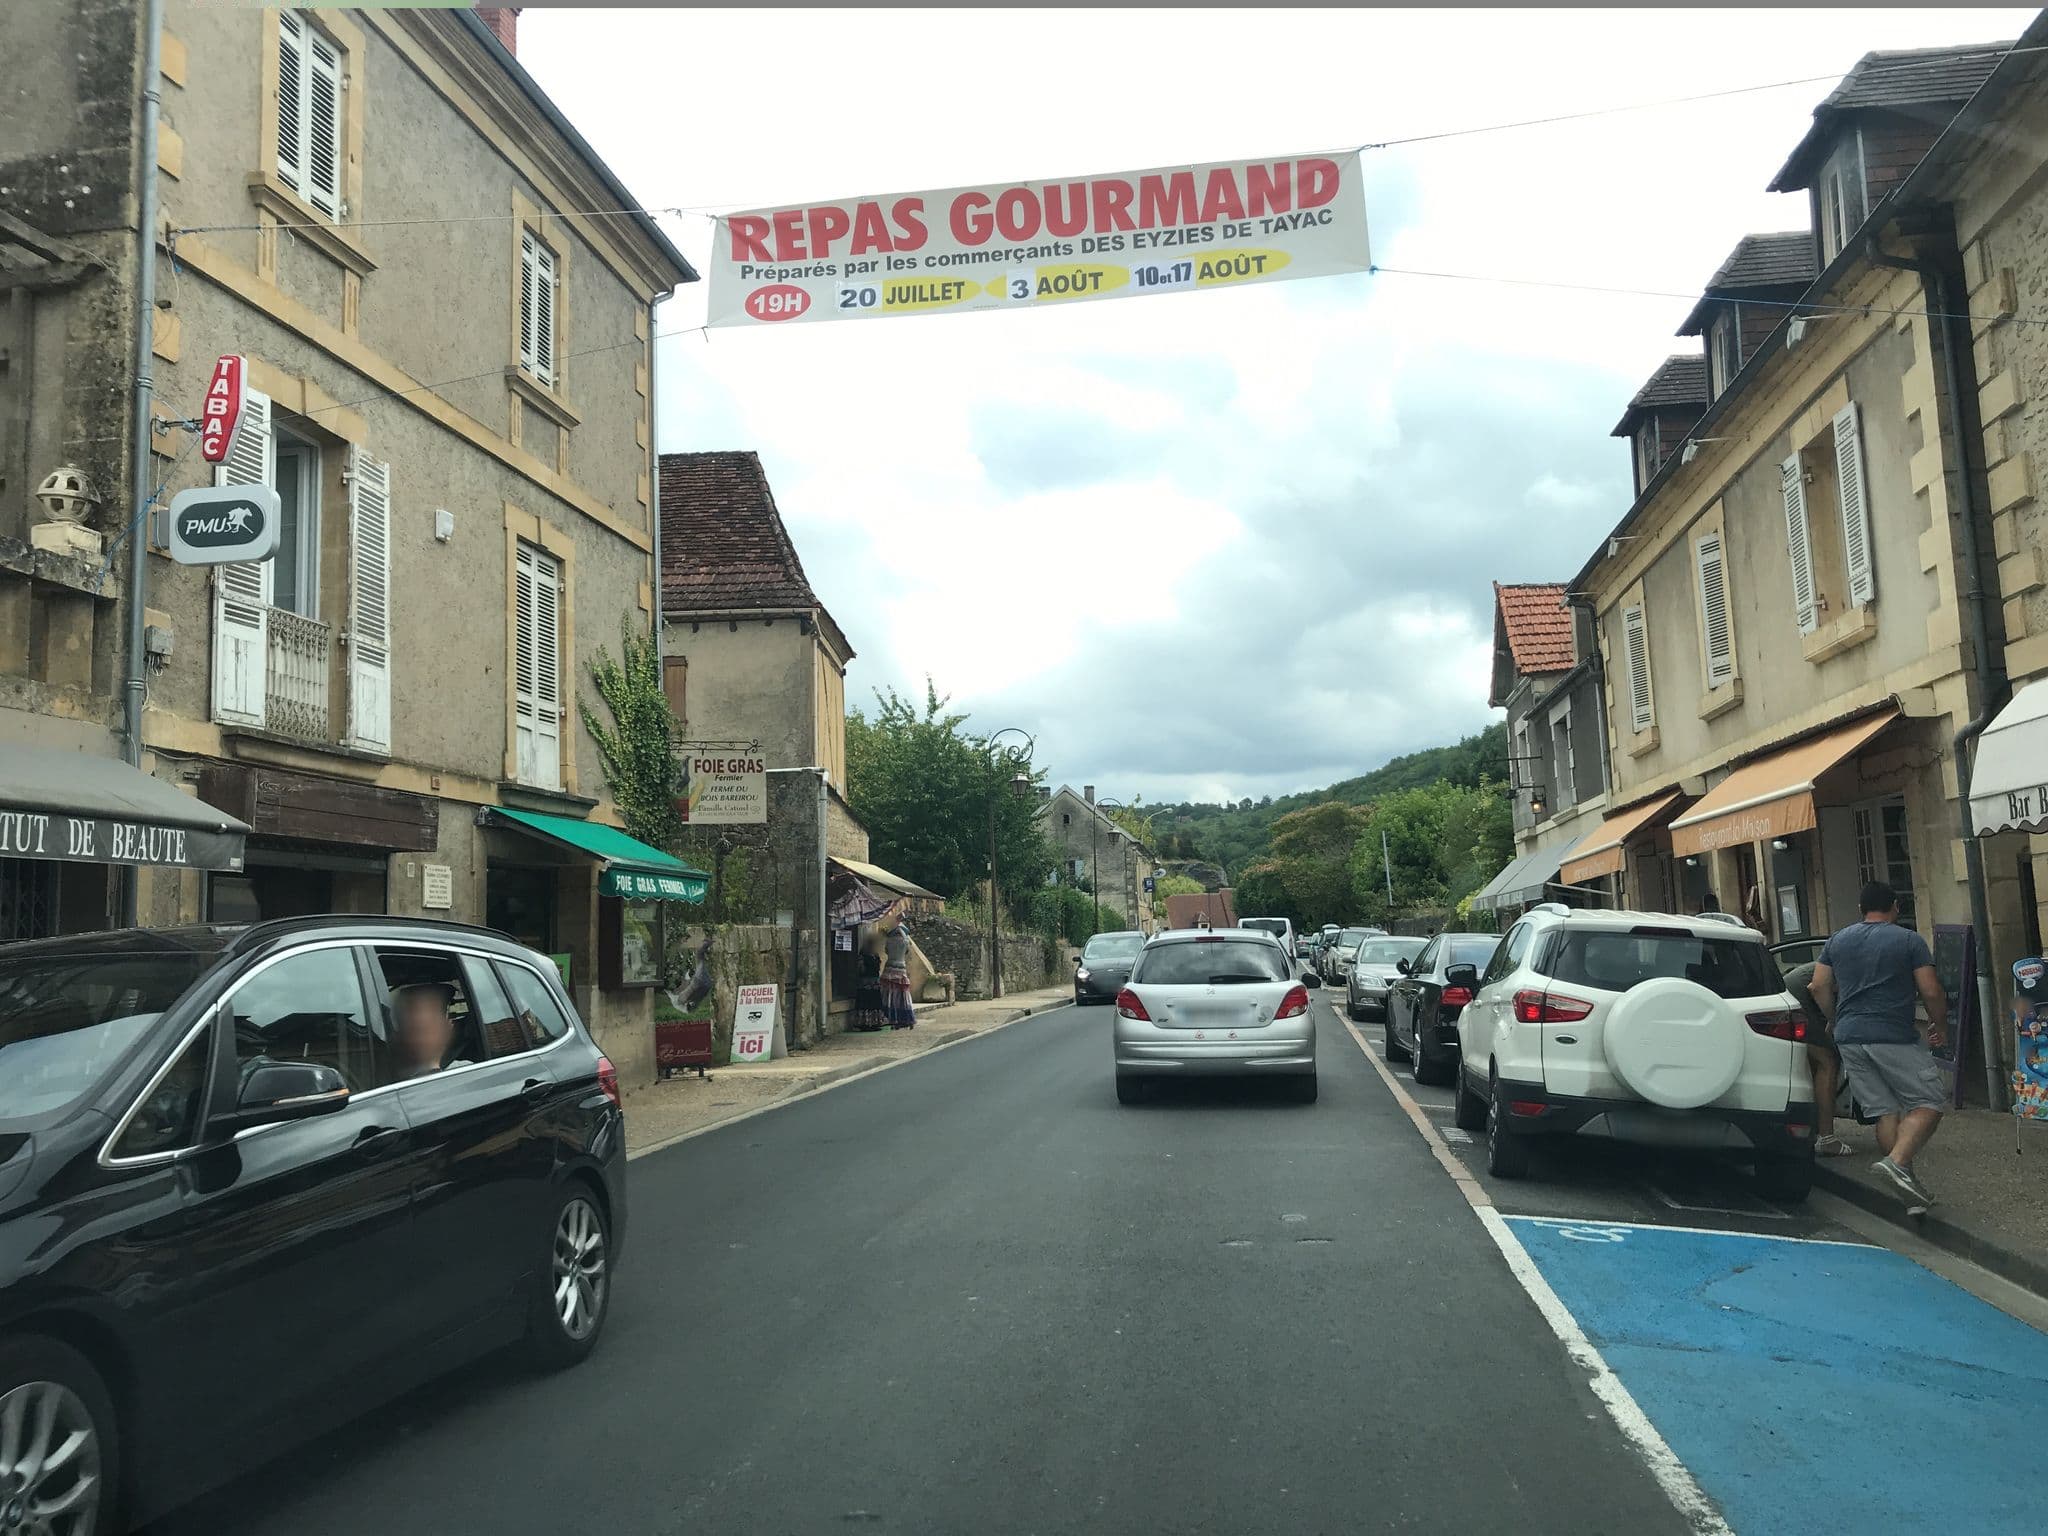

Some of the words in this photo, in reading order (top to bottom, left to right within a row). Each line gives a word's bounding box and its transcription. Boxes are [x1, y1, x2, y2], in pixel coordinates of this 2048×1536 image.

[728, 197, 928, 262] REPAS
[950, 158, 1340, 246] GOURMAND
[740, 263, 837, 283] Préparés
[844, 259, 879, 278] par
[886, 255, 918, 271] les
[923, 239, 1074, 267] commerçants
[1081, 235, 1125, 254] DES
[1133, 226, 1214, 249] EYZIES
[1222, 222, 1252, 240] DE
[1259, 208, 1332, 234] TAYAC
[1198, 254, 1267, 280] AOÛT
[840, 287, 877, 309] 20
[885, 281, 965, 305] JUILLET
[1011, 279, 1030, 299] 3
[1036, 269, 1104, 296] AOÛT
[753, 292, 803, 314] 19H
[204, 358, 233, 455] TABAC
[185, 517, 226, 536] PMU
[694, 759, 724, 773] FOIE
[728, 759, 763, 773] GRAS
[710, 785, 734, 793] FERME
[736, 785, 748, 793] DU
[2007, 791, 2030, 819] Bar
[0, 812, 49, 853] TUT
[68, 818, 95, 857] DE
[112, 823, 186, 863] BEAUTE
[615, 875, 632, 891] FOIE
[636, 877, 657, 893] GRAS
[740, 987, 774, 997] ACCUEIL
[739, 1035, 764, 1054] ici
